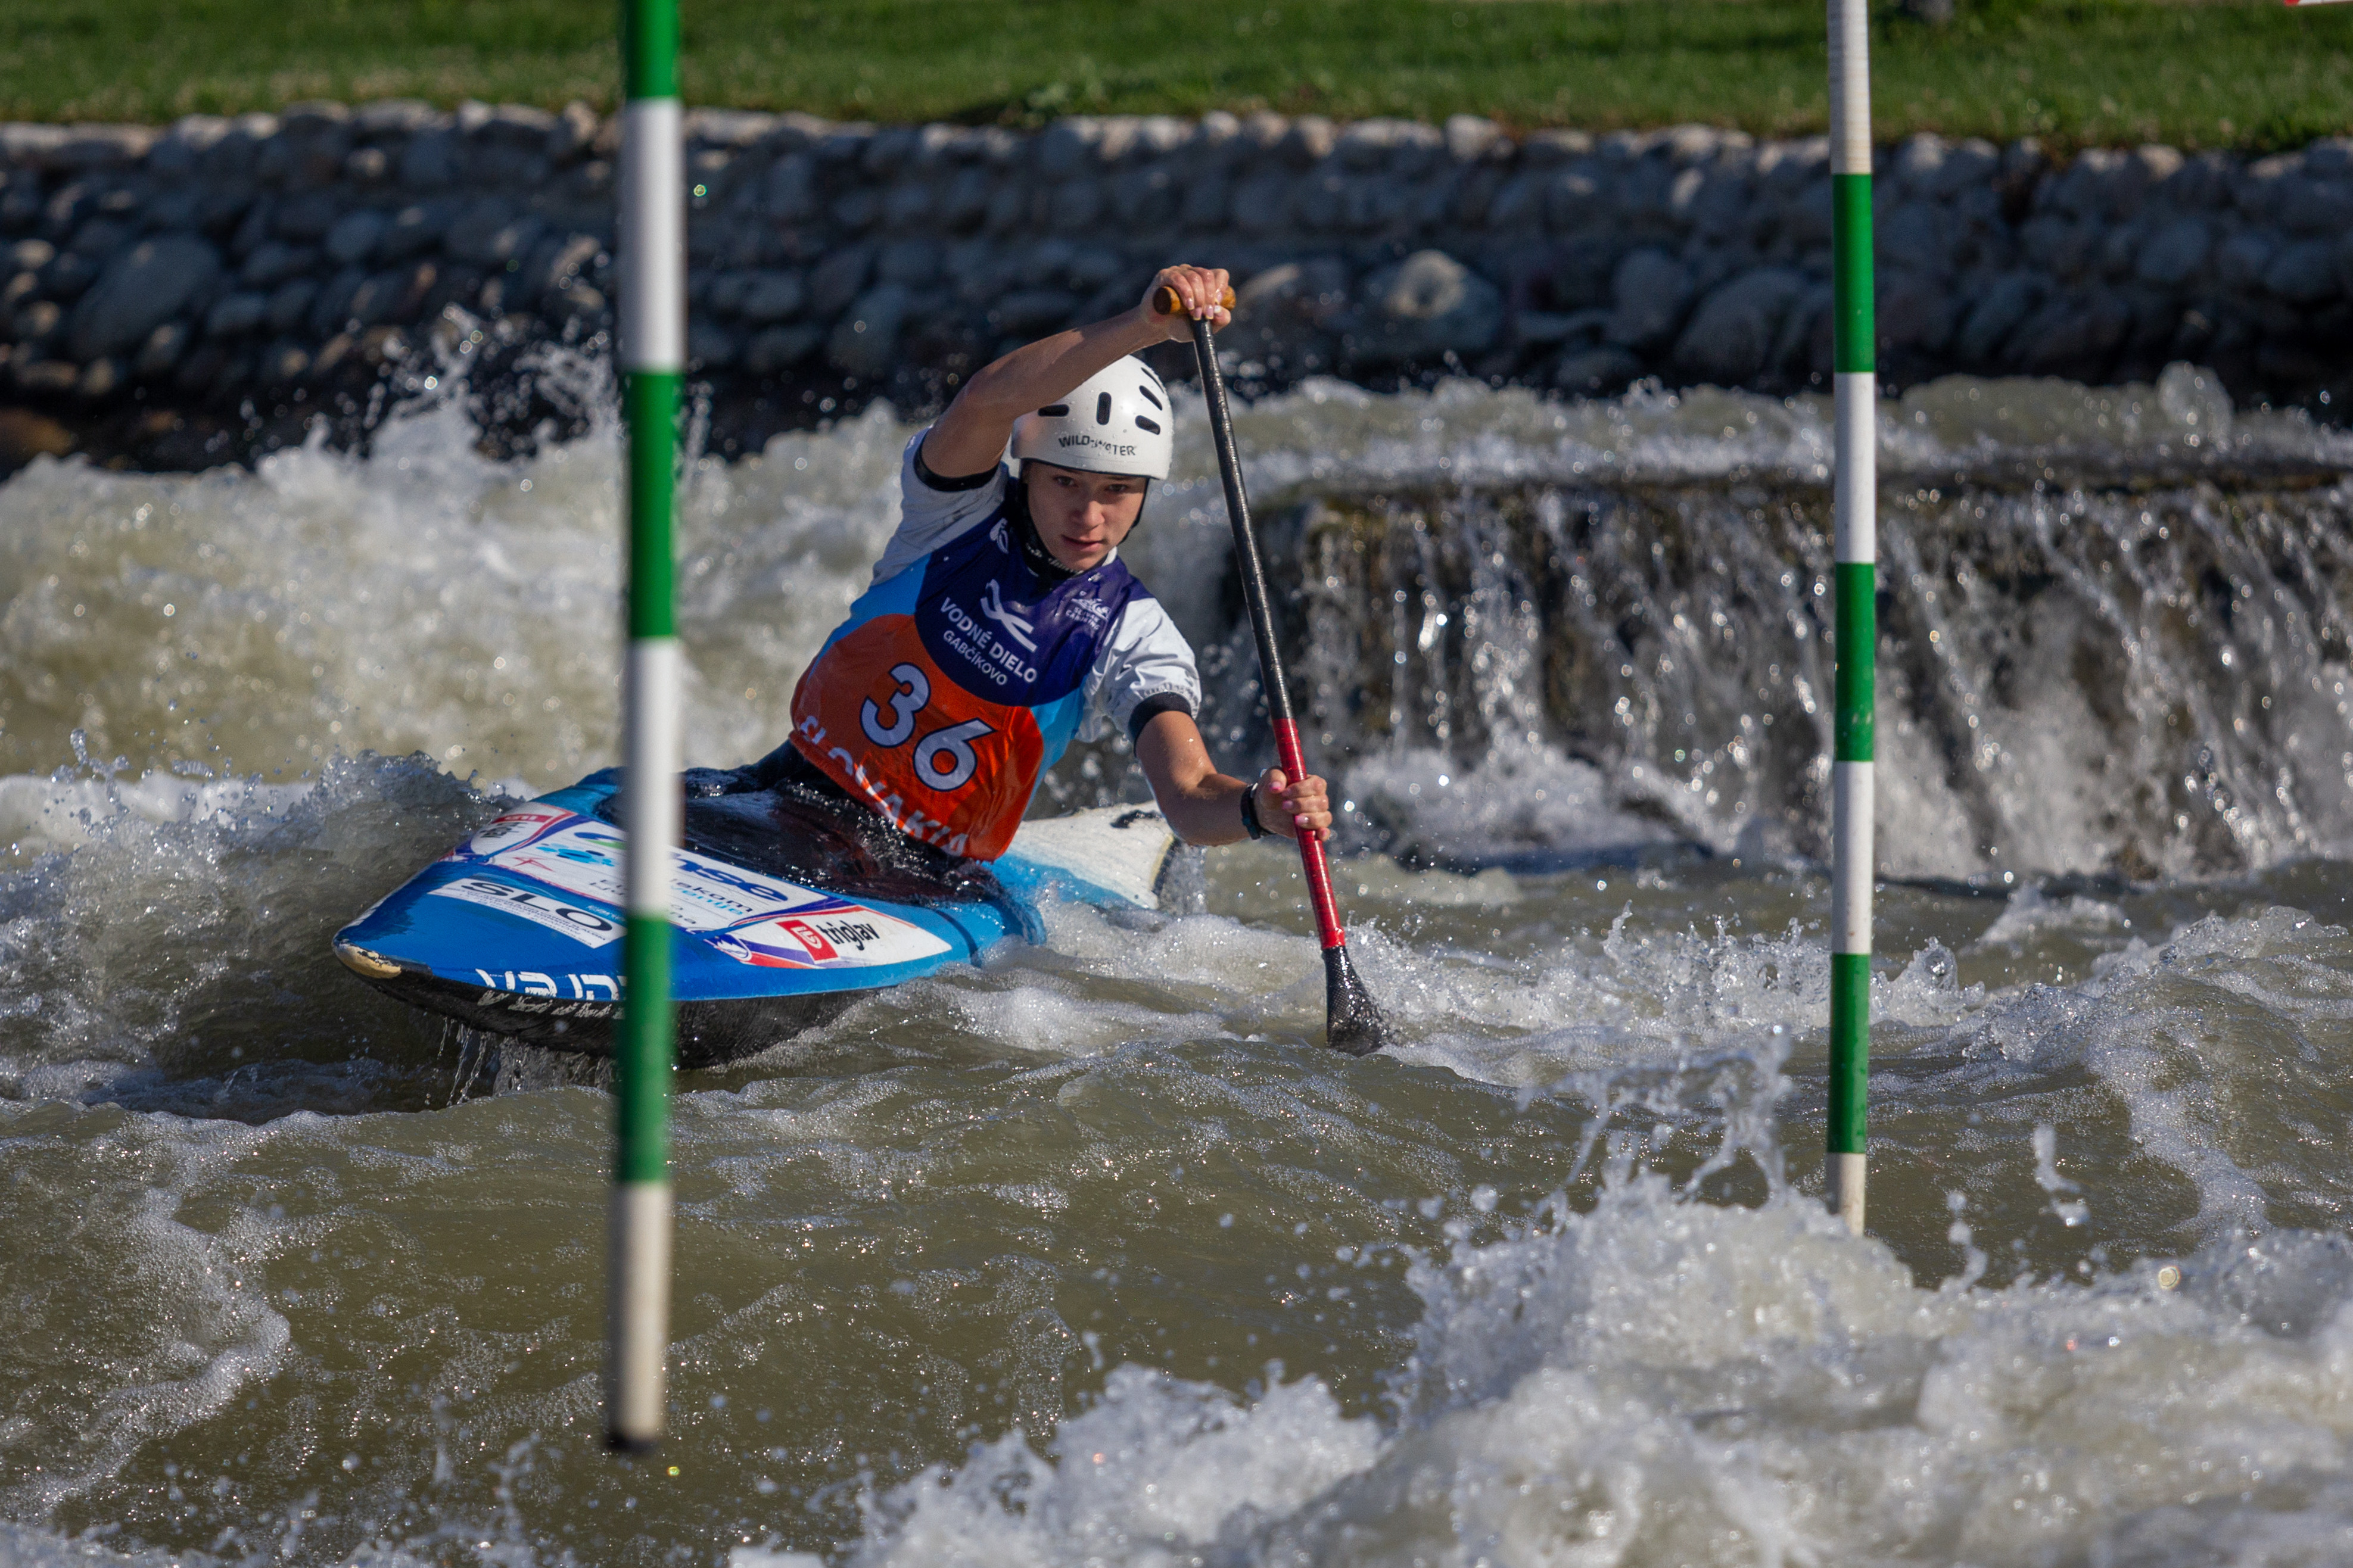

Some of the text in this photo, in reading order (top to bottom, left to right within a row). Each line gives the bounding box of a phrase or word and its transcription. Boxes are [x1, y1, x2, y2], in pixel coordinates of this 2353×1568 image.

[939, 597, 1039, 684] VODNÉ DIELO
[942, 629, 1009, 686] GABČÍKOVO
[860, 662, 997, 792] 36
[460, 882, 612, 931] SLO
[816, 920, 880, 951] triglav
